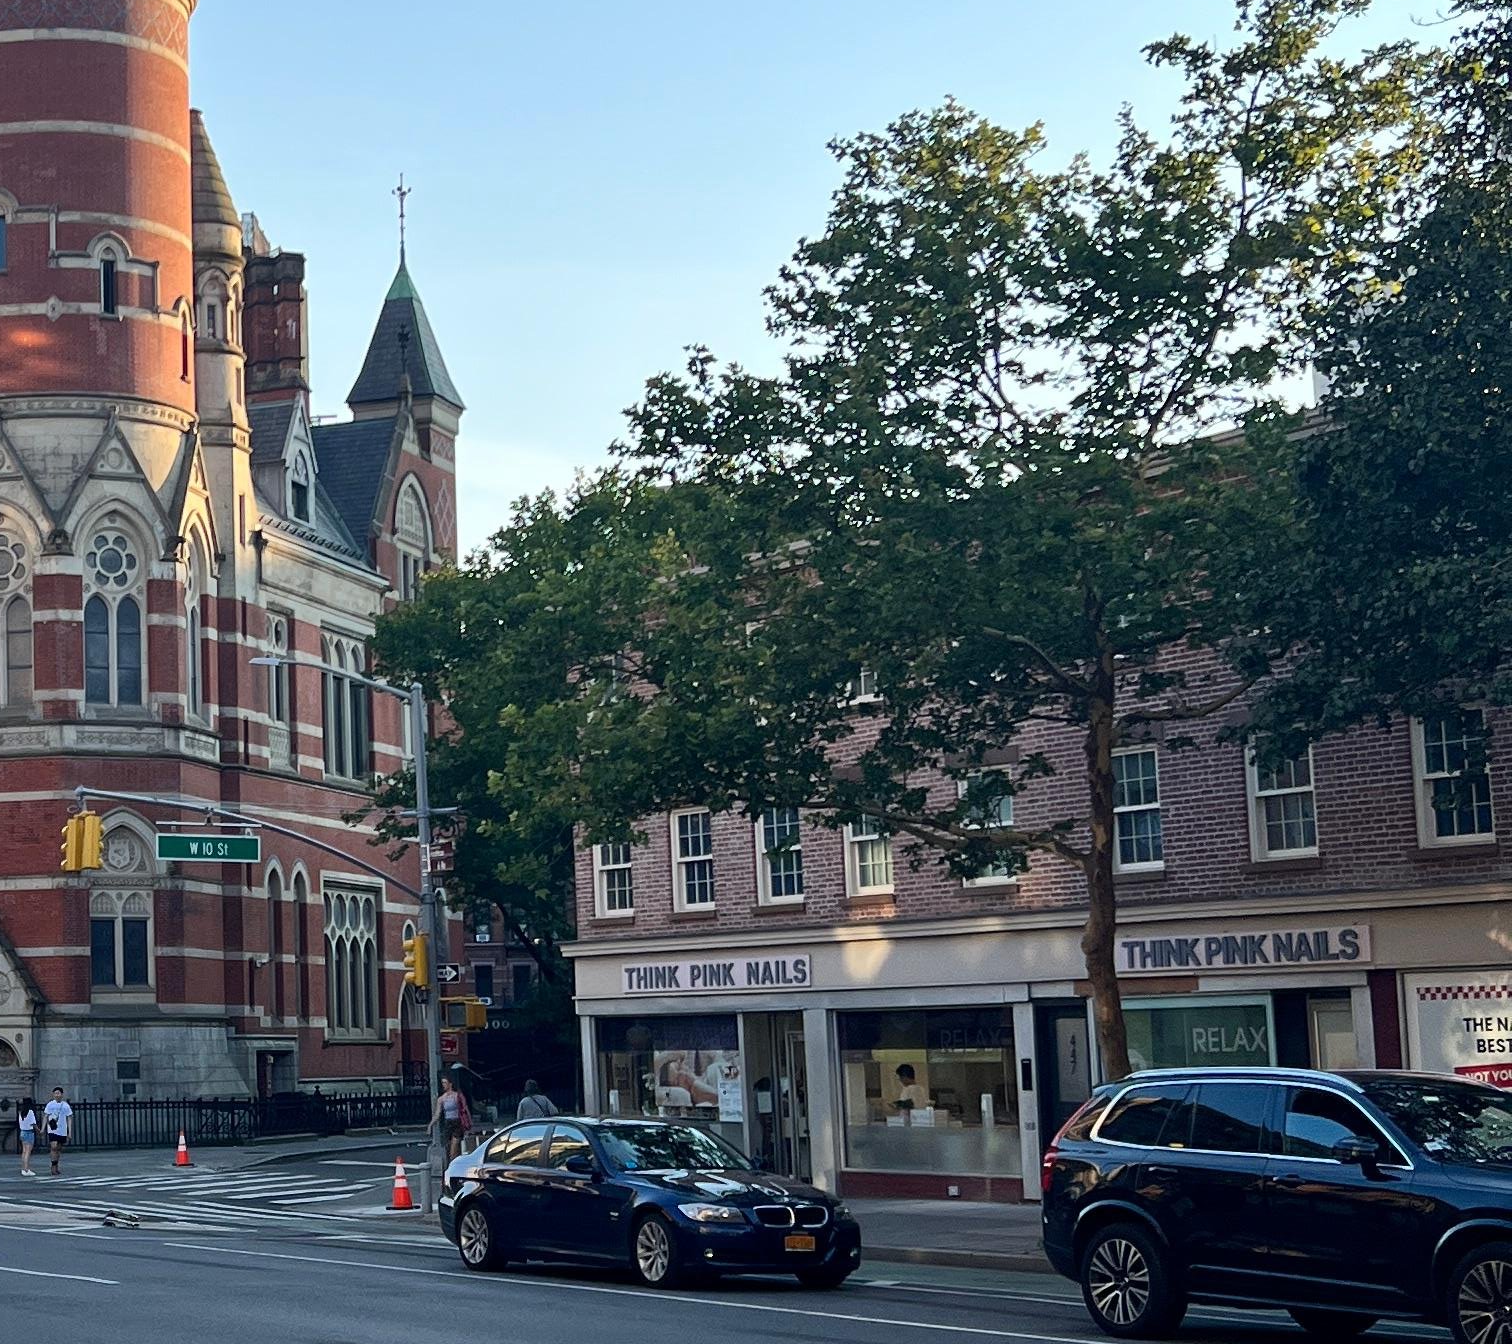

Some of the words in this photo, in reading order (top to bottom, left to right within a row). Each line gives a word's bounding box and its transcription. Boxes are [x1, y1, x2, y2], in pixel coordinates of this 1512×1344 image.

[189, 842, 199, 855] W
[202, 842, 213, 856] 10
[217, 842, 229, 856] St
[1121, 937, 1202, 969] THINK
[1204, 934, 1269, 966] PINK
[1272, 929, 1359, 962] NAILS
[624, 965, 680, 990] THINK
[690, 962, 735, 987] PINK
[746, 959, 807, 985] NAILS
[1462, 1017, 1493, 1032] THE
[1497, 1017, 1512, 1032] N
[1192, 1026, 1267, 1053] RELAX
